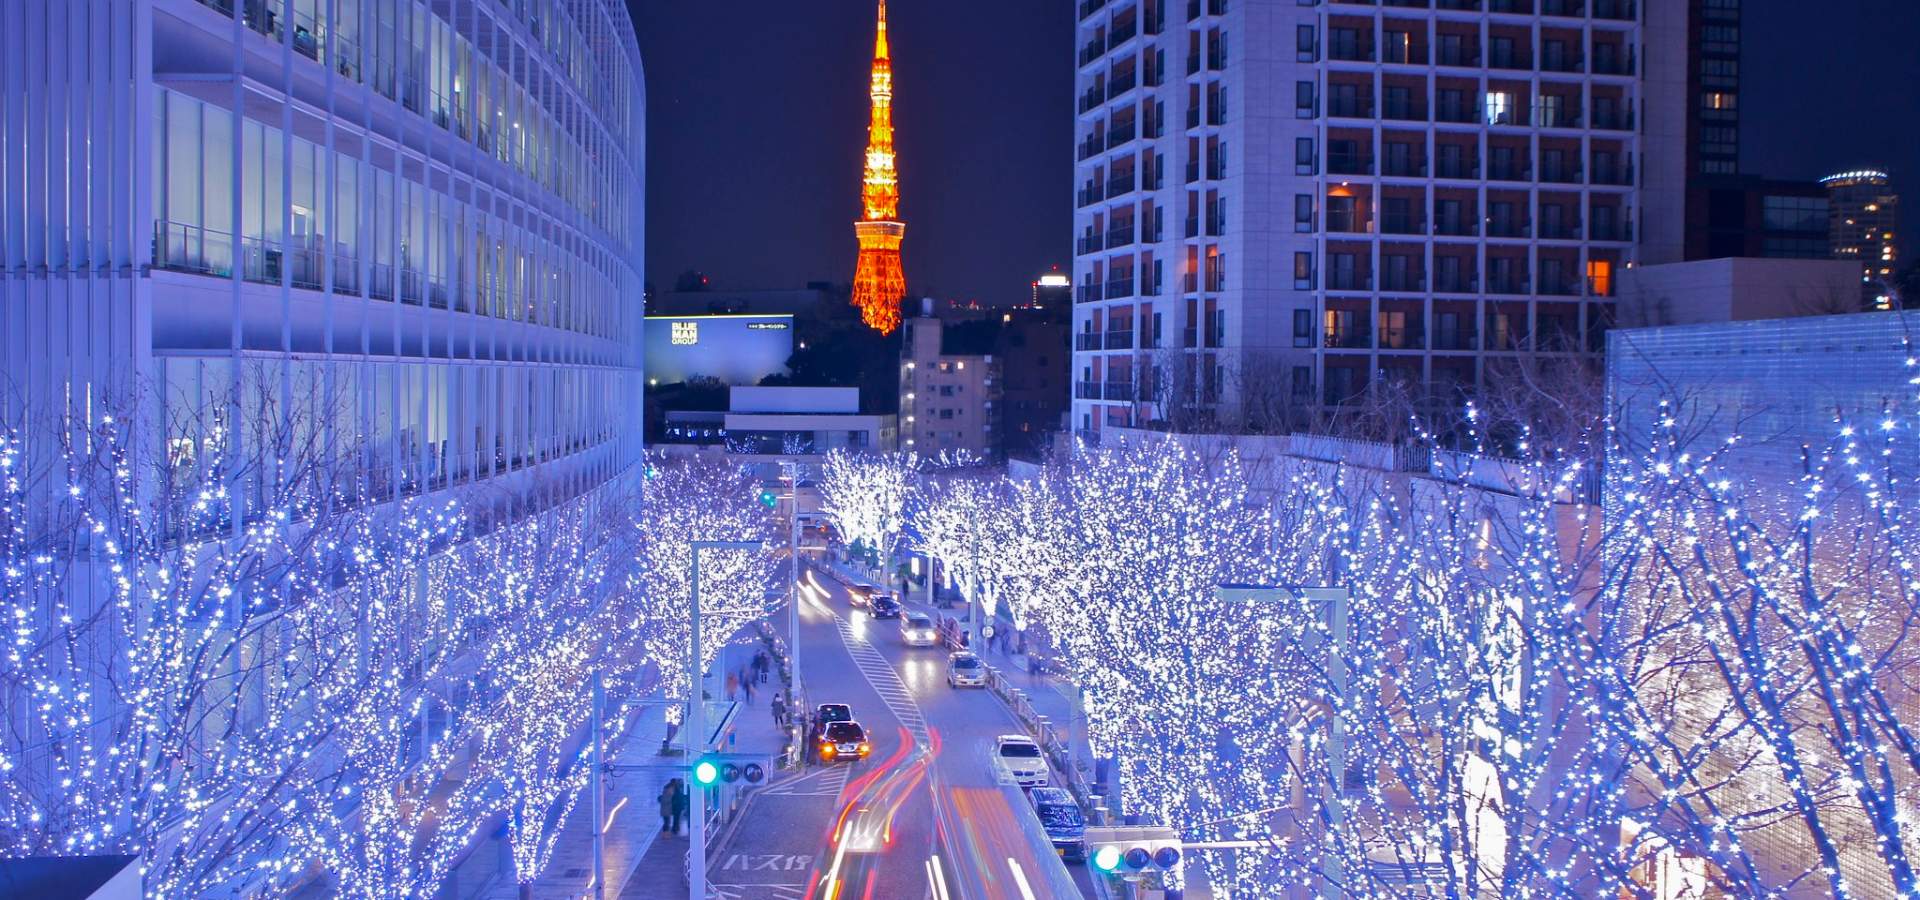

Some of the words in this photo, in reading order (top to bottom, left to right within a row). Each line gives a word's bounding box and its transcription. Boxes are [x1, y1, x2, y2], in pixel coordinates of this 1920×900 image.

[672, 322, 697, 330] BLUE
[672, 330, 697, 338] MAN
[722, 854, 814, 871] バス停
